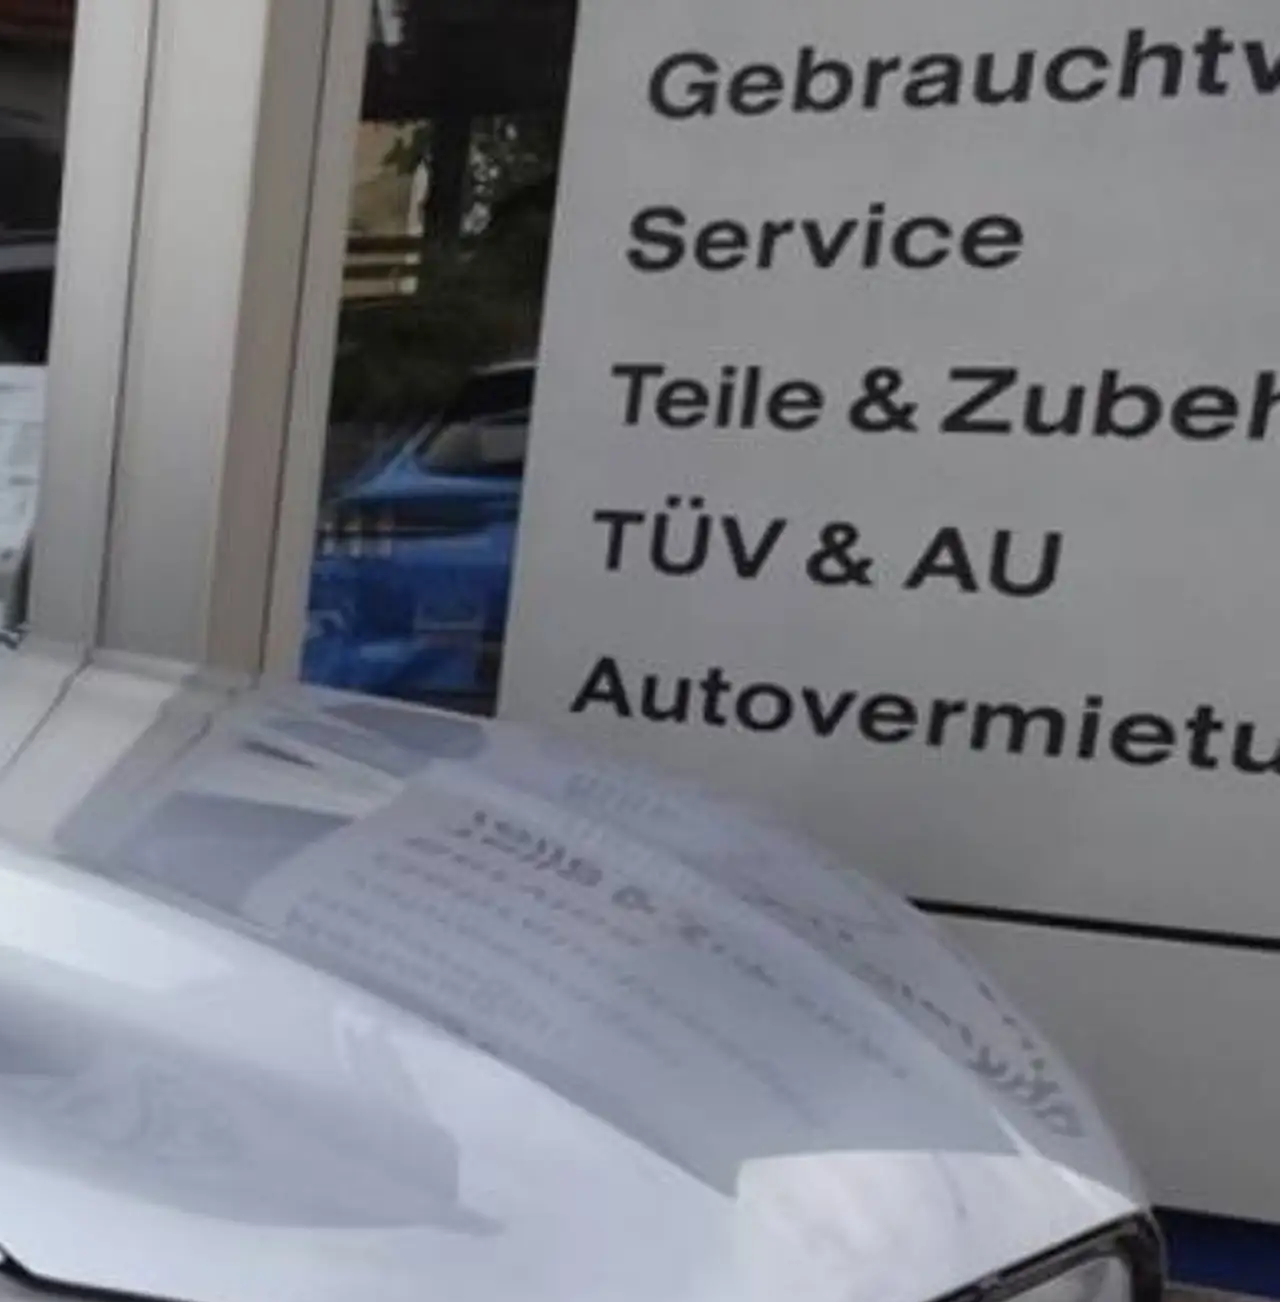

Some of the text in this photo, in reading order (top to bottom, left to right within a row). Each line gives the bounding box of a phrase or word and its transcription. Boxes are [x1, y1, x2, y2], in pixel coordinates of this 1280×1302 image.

[625, 201, 1026, 273] Service
[610, 363, 825, 432] Teile
[848, 366, 919, 435] &
[593, 495, 1063, 598] TÜV & AU
[570, 656, 1280, 778] Autovermietu
